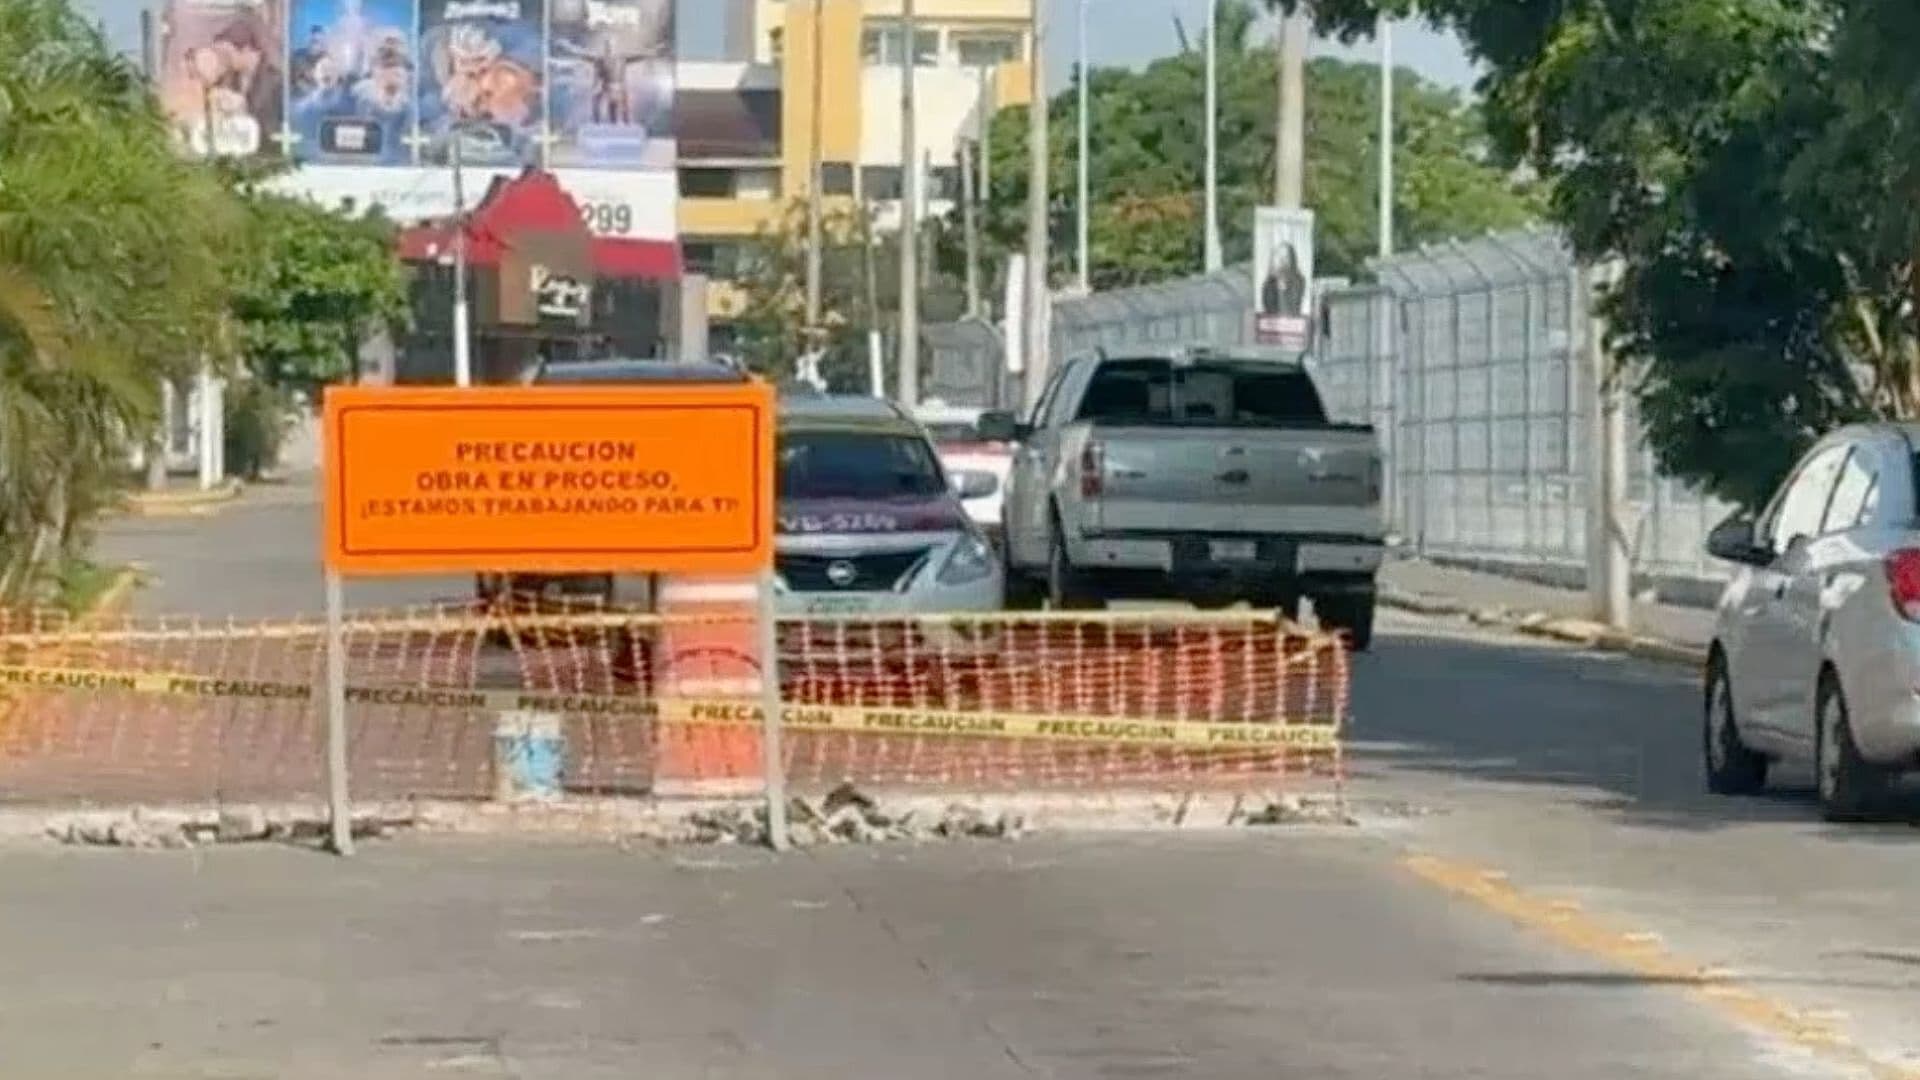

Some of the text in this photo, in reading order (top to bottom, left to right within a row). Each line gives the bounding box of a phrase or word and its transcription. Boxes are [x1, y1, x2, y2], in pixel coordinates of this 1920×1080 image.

[416, 470, 678, 492] OBRA EN PROCESO,
[485, 497, 638, 515] TRABAJANDO
[644, 496, 704, 514] PARA
